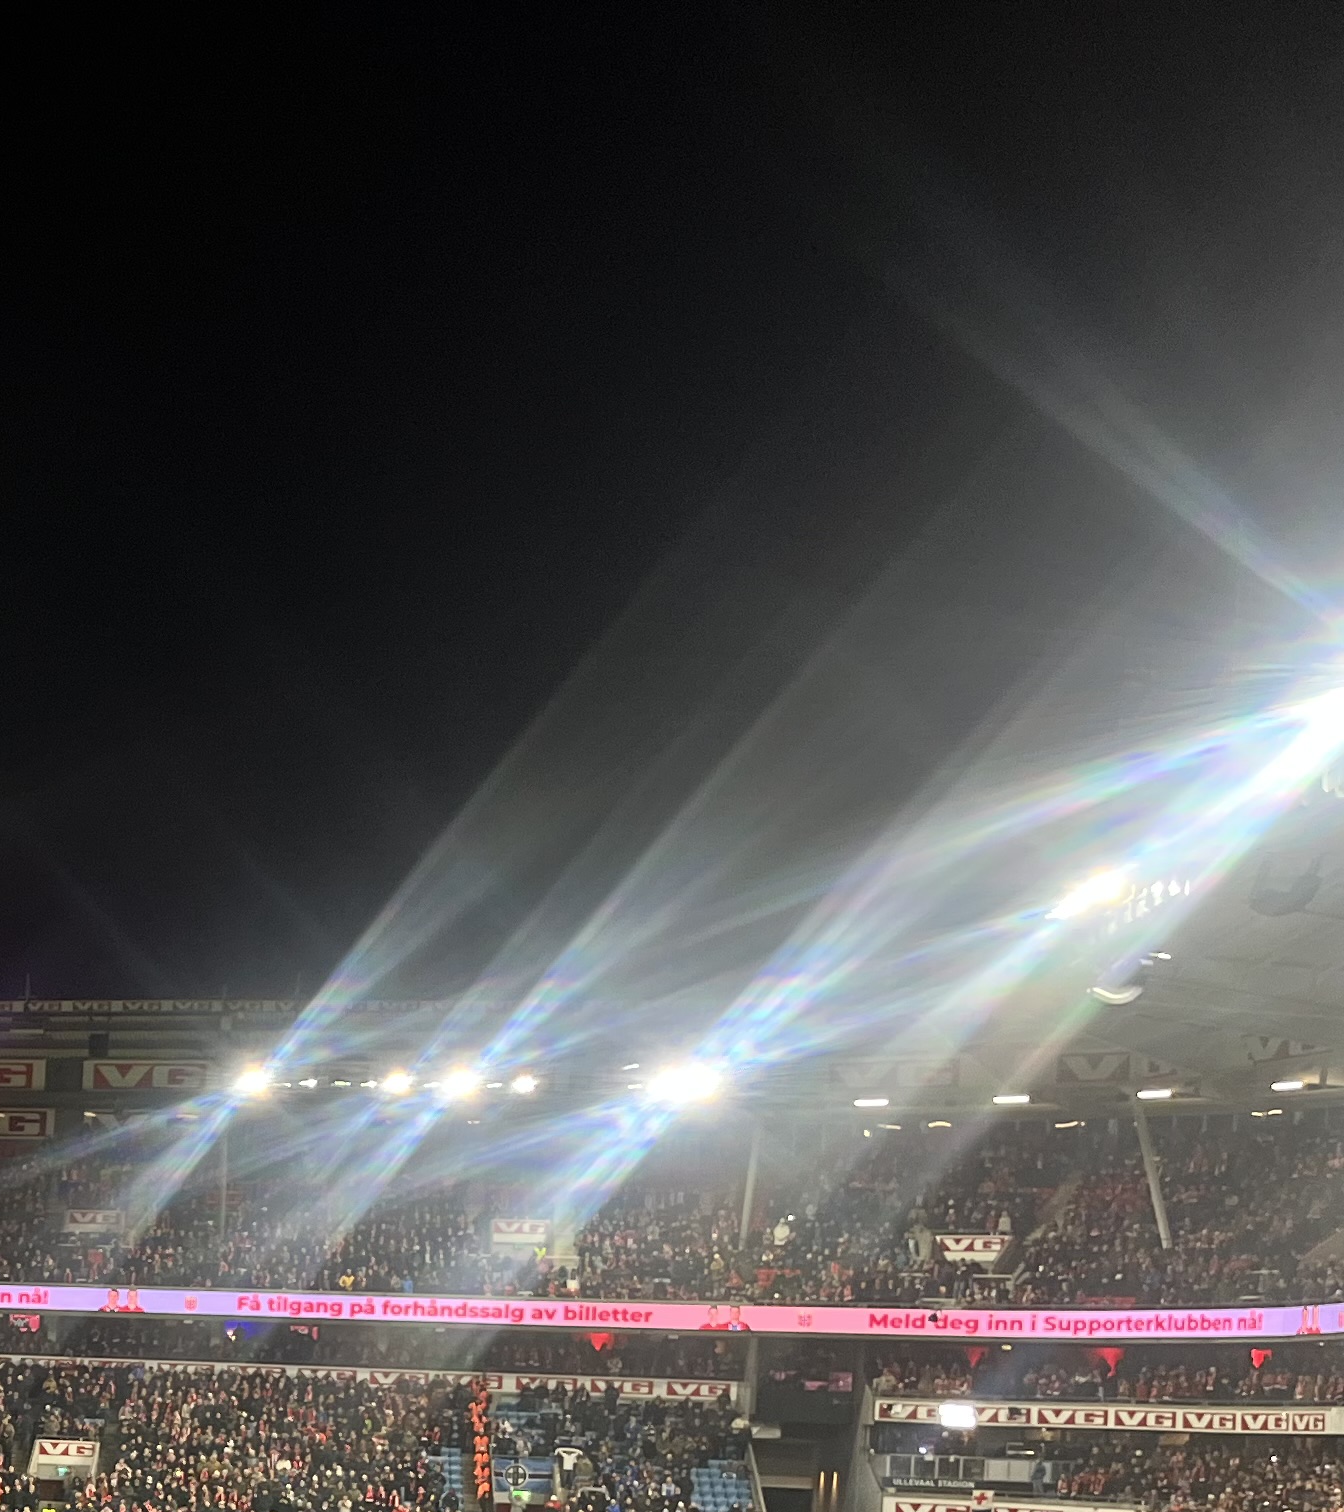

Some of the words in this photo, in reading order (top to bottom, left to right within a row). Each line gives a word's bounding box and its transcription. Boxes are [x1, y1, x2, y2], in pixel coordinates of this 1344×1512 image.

[95, 1064, 204, 1088] VG
[495, 1222, 545, 1234] VG
[941, 1238, 1001, 1251] VG
[17, 1287, 49, 1305] nå!
[236, 1293, 261, 1311] Få
[267, 1296, 342, 1317] tilgang
[349, 1298, 376, 1318] på
[381, 1297, 524, 1322] forhåndssalg
[531, 1307, 558, 1321] av
[563, 1304, 653, 1324] billetter
[869, 1312, 925, 1329] Meld
[934, 1314, 979, 1333] deg
[988, 1313, 1023, 1331] inn
[1031, 1314, 1037, 1331] i
[1043, 1314, 1232, 1335] Supporterklubben
[1237, 1309, 1264, 1331] nå!
[668, 1382, 728, 1397] VG
[1039, 1409, 1107, 1426] VG
[1116, 1410, 1175, 1428] VG
[1185, 1413, 1234, 1430] VG
[1243, 1414, 1288, 1430] VG
[1294, 1414, 1324, 1431] VG
[41, 1442, 93, 1457] VG
